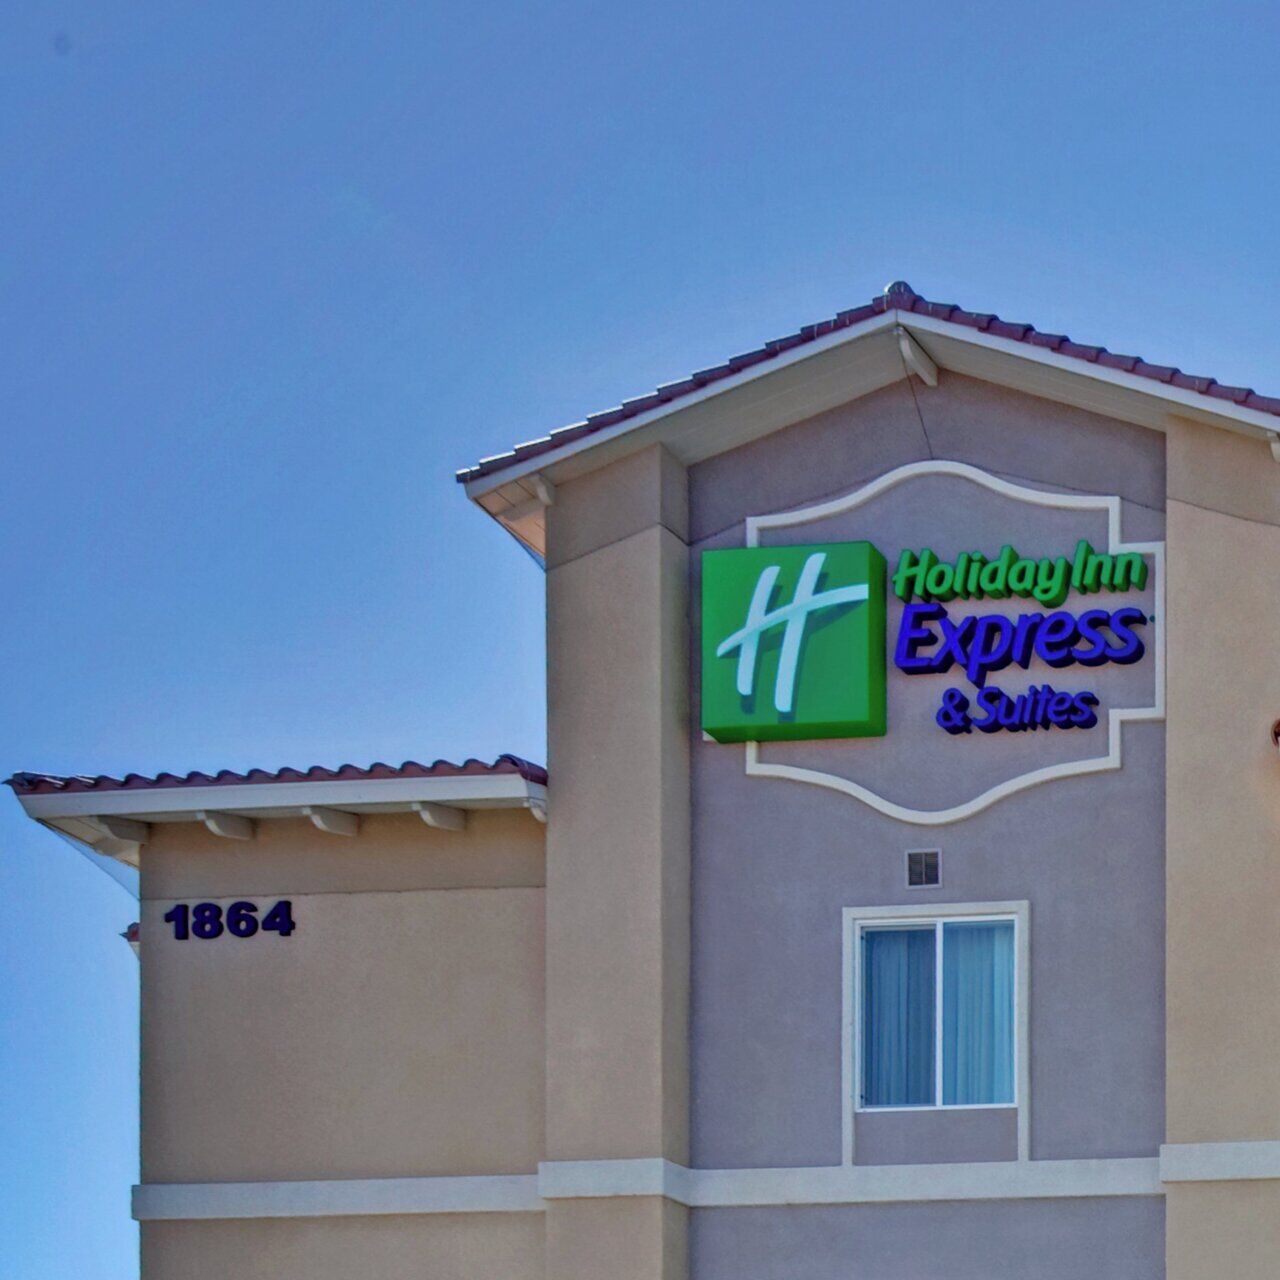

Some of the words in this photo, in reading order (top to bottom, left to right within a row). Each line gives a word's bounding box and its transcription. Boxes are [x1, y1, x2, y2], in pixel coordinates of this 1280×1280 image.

[892, 544, 1072, 608] Holiday
[1071, 539, 1148, 594] Inn
[894, 602, 1147, 688] Express
[936, 687, 972, 734] &
[972, 684, 1099, 733] Suites
[164, 900, 295, 940] 1864
